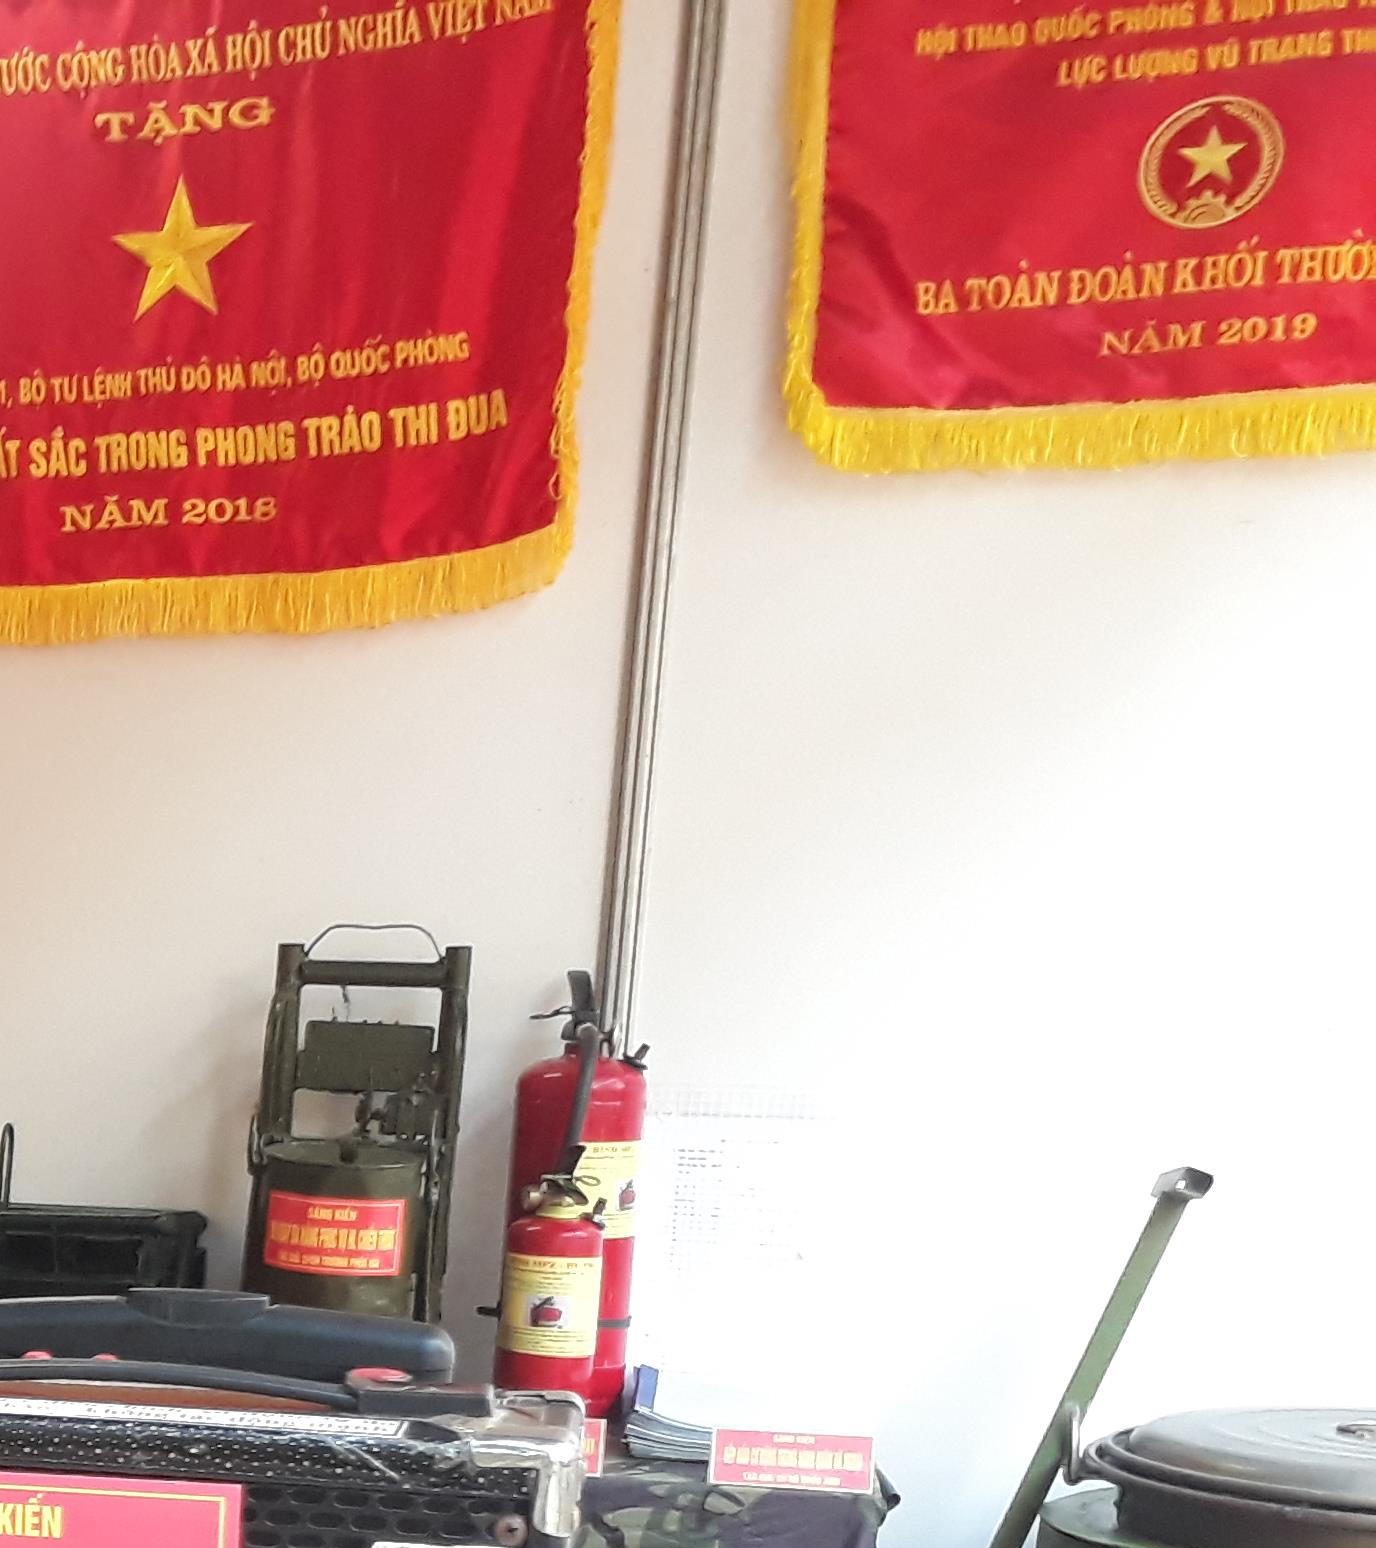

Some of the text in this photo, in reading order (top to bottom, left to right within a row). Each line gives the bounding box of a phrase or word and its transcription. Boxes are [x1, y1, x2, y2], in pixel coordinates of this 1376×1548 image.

[57, 39, 126, 99] CỘNG
[130, 33, 183, 84] HÒA
[225, 19, 272, 81] HỘI
[278, 5, 333, 66] CHỦ
[427, 0, 487, 44] VIỆT
[1057, 53, 1107, 88] LỰC
[1249, 29, 1334, 65] TRANG
[95, 95, 276, 146] TẶNG
[915, 278, 959, 316] BA
[965, 258, 1062, 312] TOÀN
[1066, 249, 1168, 304] ĐOÀN
[1173, 234, 1268, 294] KHỐI
[82, 366, 133, 409] LỆNH
[136, 355, 177, 395] THỦ
[216, 354, 246, 393] HÀ
[297, 342, 325, 388] BỘ
[330, 334, 391, 379] QUỐC
[395, 328, 470, 371] PHÒNG
[1097, 312, 1319, 357] NĂM 2019
[29, 424, 87, 478] SẮC
[94, 428, 189, 475] TRONG
[196, 420, 296, 468] PHONG
[301, 404, 383, 459] TRÀO
[388, 401, 439, 449] THI
[447, 388, 509, 442] ĐUA
[59, 493, 277, 533] NĂM 2018
